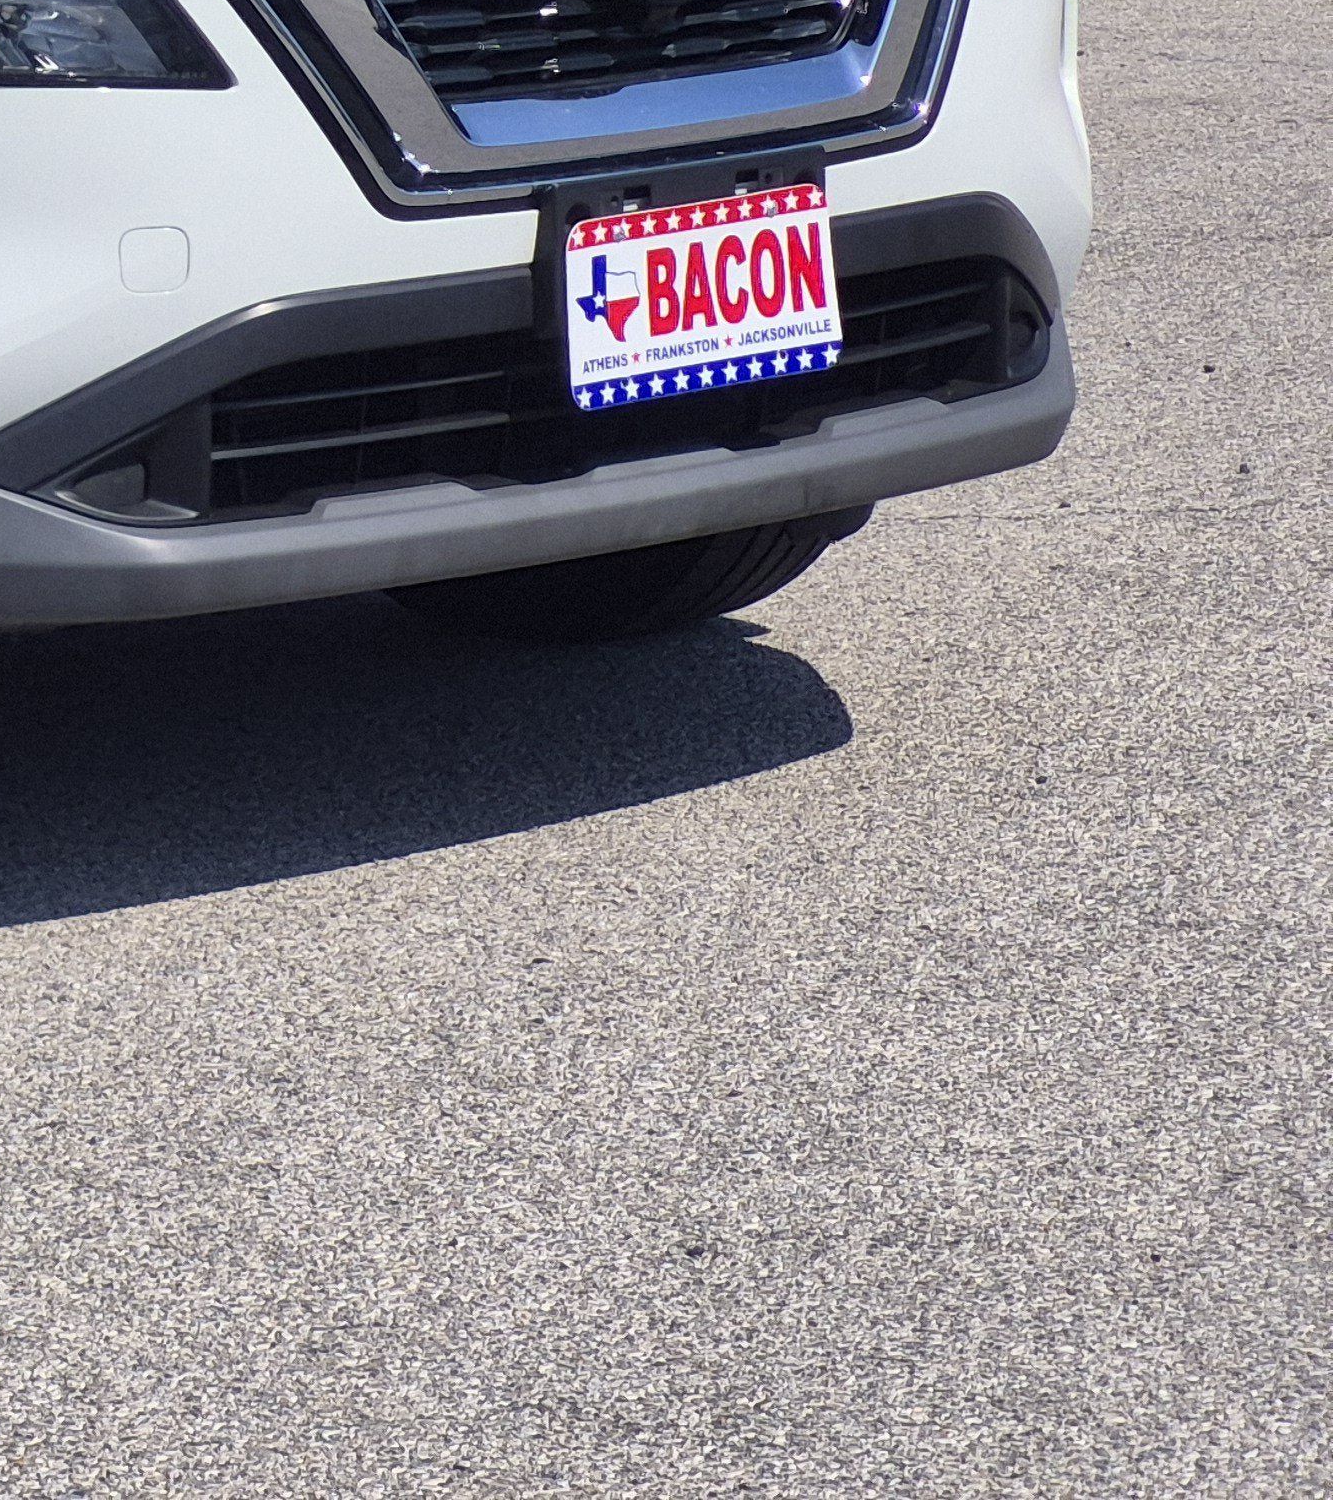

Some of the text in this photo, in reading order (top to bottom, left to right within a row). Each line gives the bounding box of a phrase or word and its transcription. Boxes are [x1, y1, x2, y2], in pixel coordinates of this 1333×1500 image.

[646, 221, 827, 338] BACON
[582, 318, 832, 375] ATHENS FRANKSTON JACKSONVILLE
